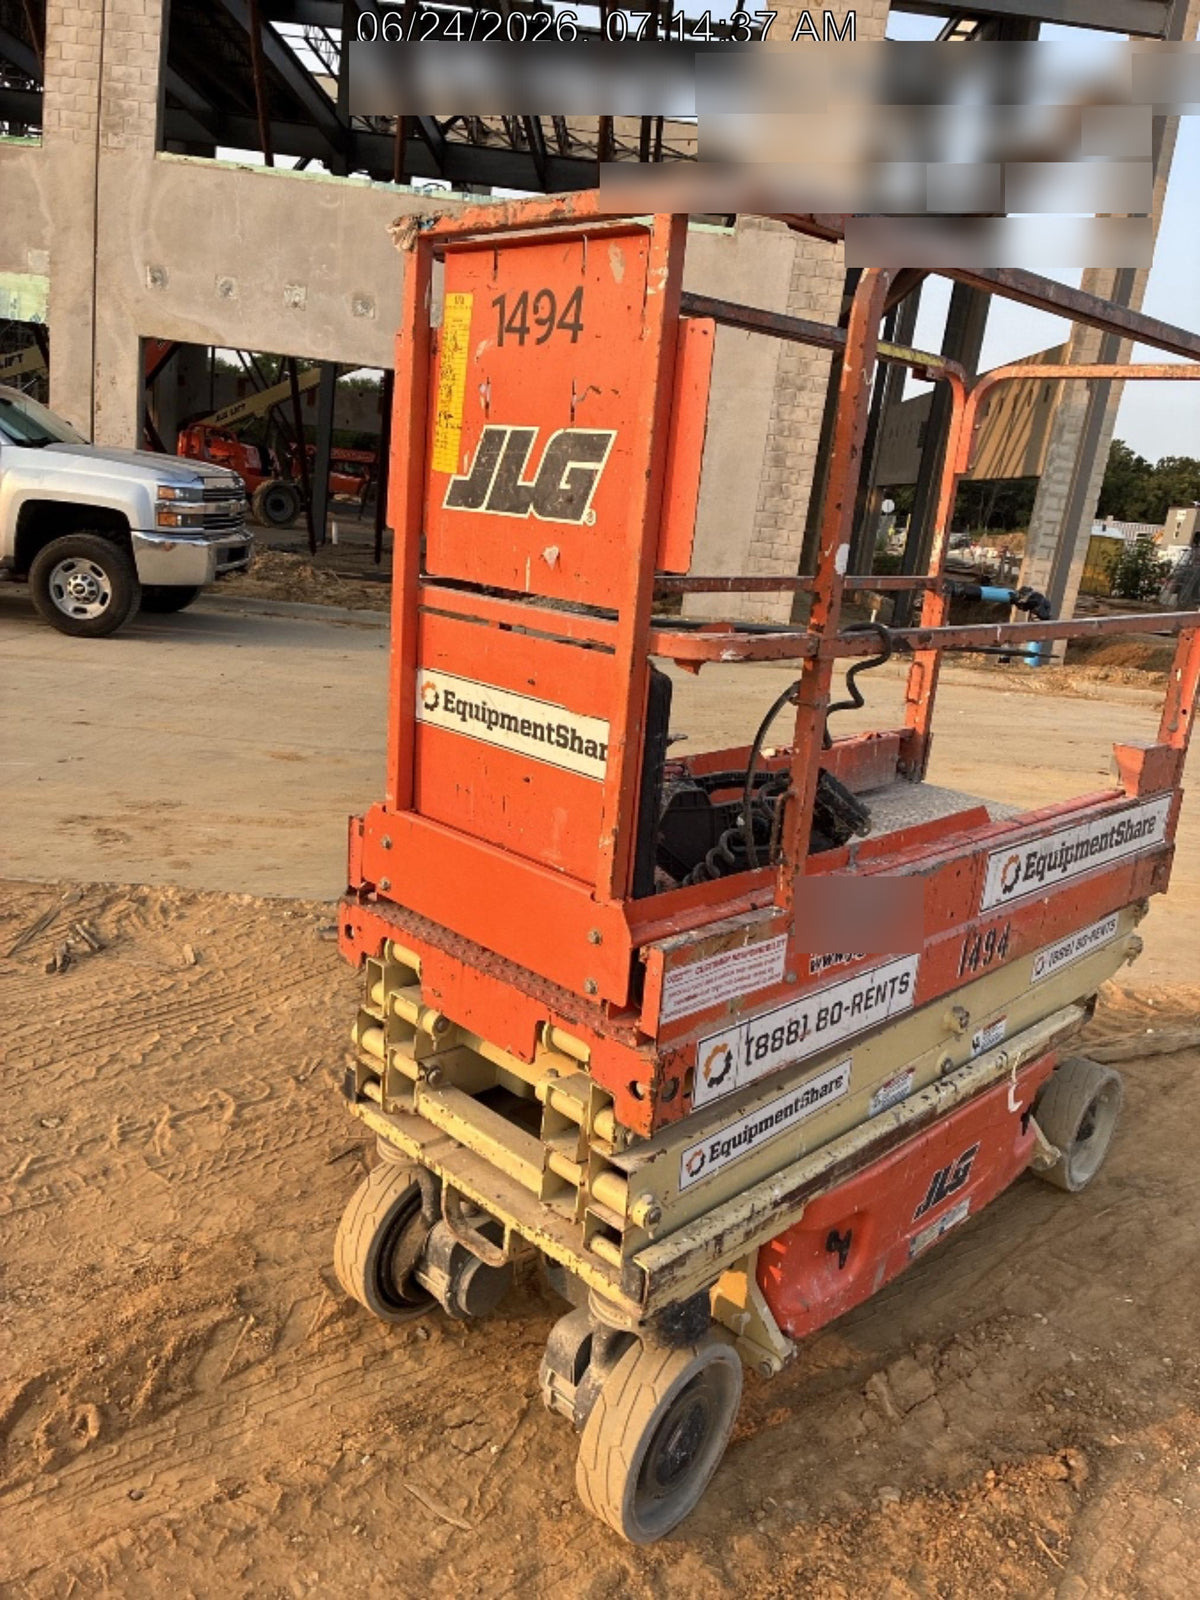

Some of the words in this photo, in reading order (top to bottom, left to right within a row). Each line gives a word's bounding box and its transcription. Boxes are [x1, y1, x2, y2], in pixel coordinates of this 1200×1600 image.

[491, 285, 584, 347] 1494
[442, 424, 618, 525] JLG
[442, 688, 609, 762] EquipmentShar
[1021, 814, 1157, 882] EquipmentShare
[957, 922, 1011, 979] 1494
[815, 972, 911, 1032] 80-RENTS
[708, 1073, 844, 1164] EquipmentShare
[911, 1142, 981, 1224] JLG
